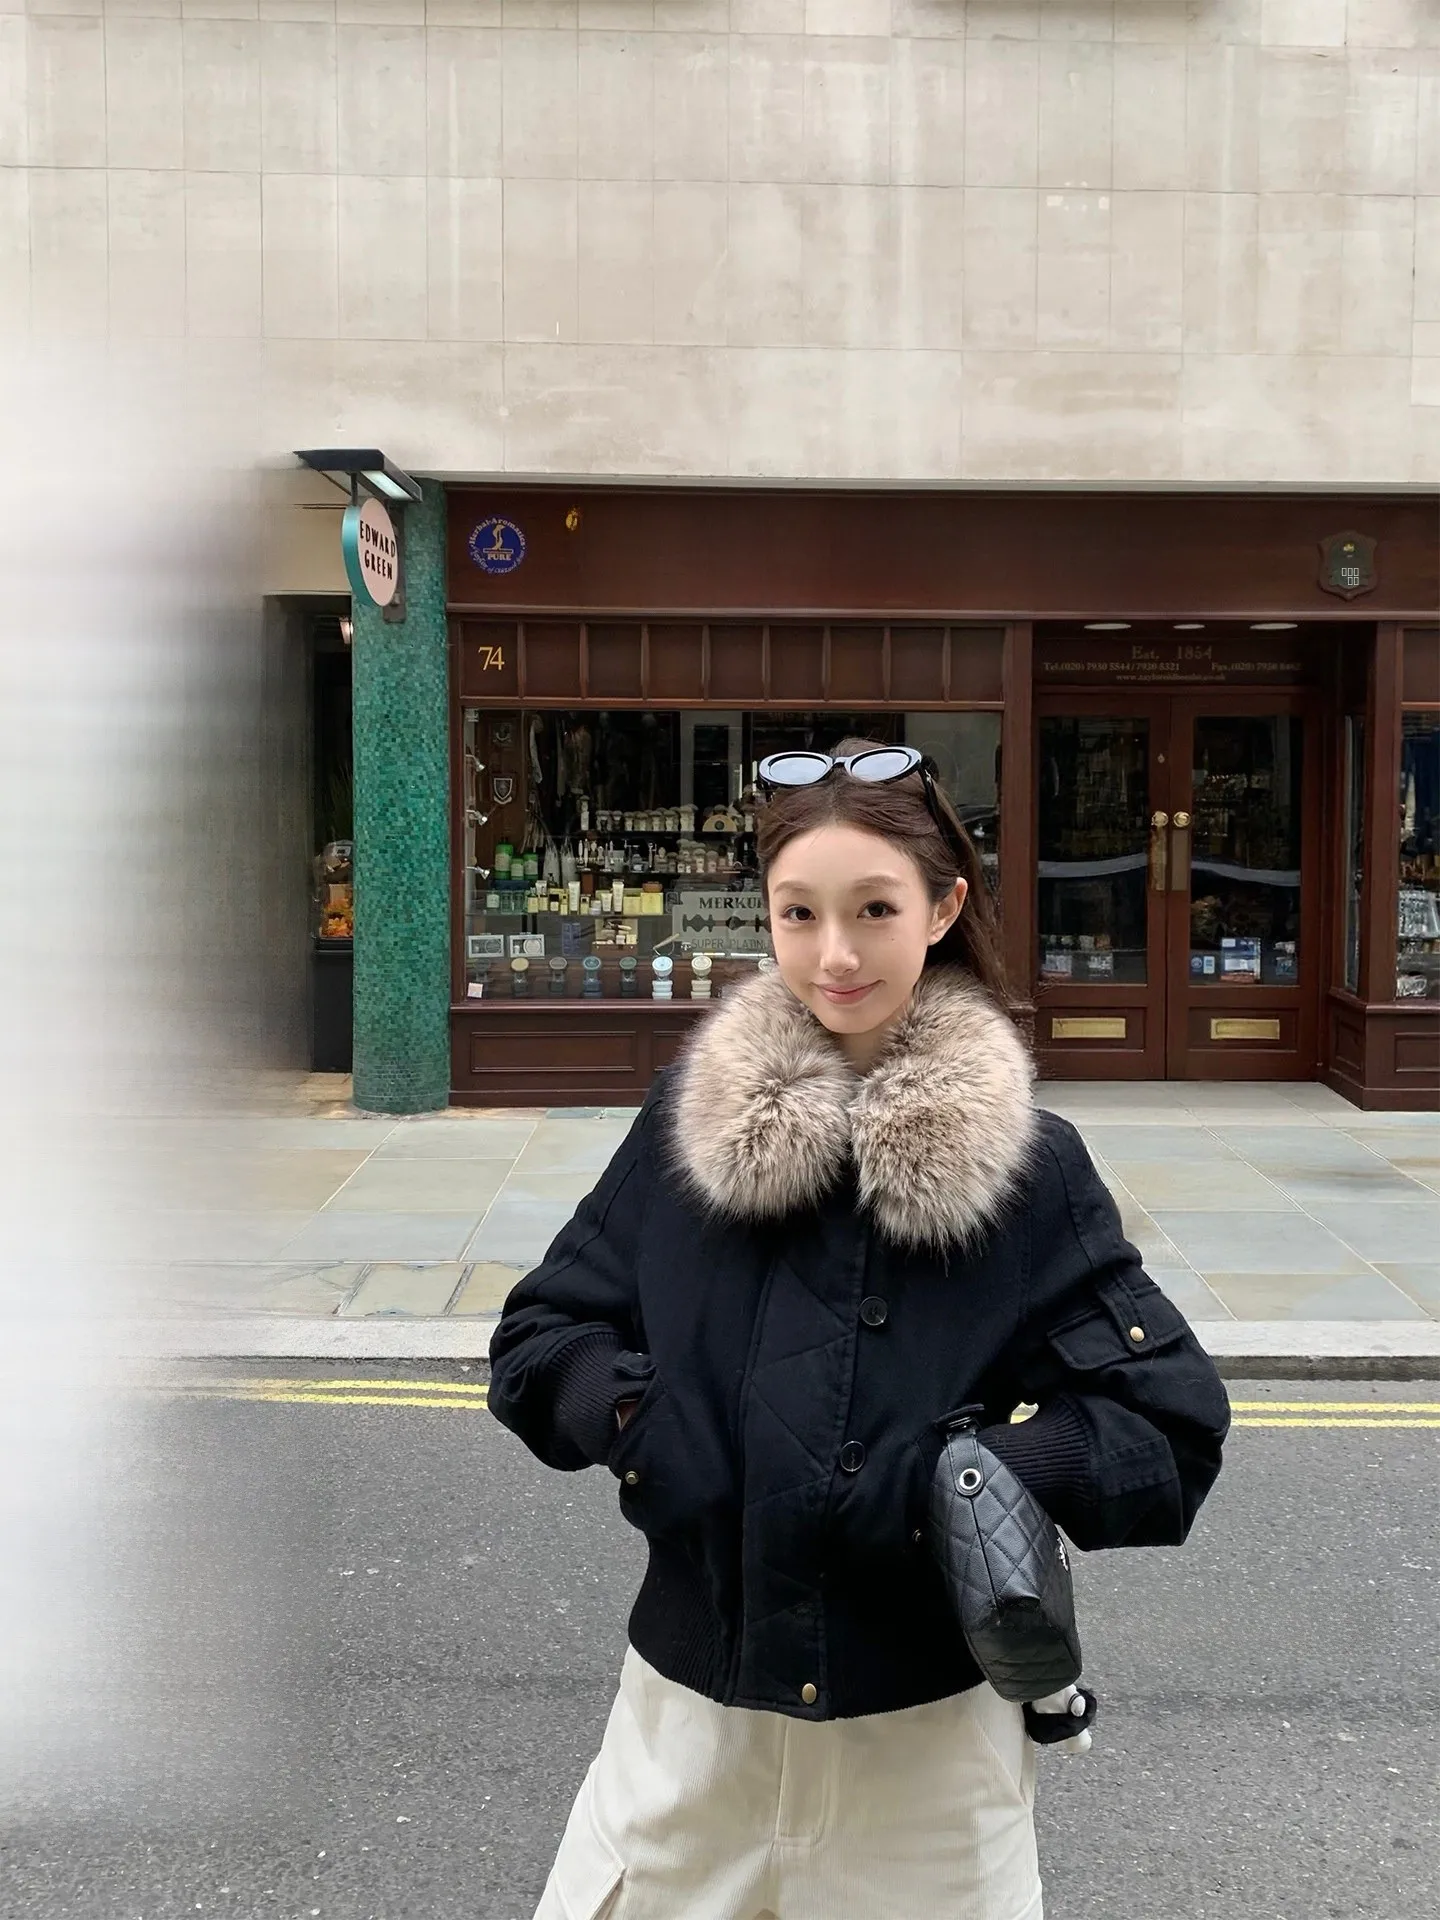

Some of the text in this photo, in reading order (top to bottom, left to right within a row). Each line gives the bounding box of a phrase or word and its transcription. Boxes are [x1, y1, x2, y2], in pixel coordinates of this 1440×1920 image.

[360, 520, 396, 558] EDWARD
[364, 549, 393, 580] GREEN
[487, 553, 512, 561] PURE
[478, 646, 505, 671] 74
[1132, 645, 1213, 661] Est. 1854
[691, 938, 725, 950] SUPER
